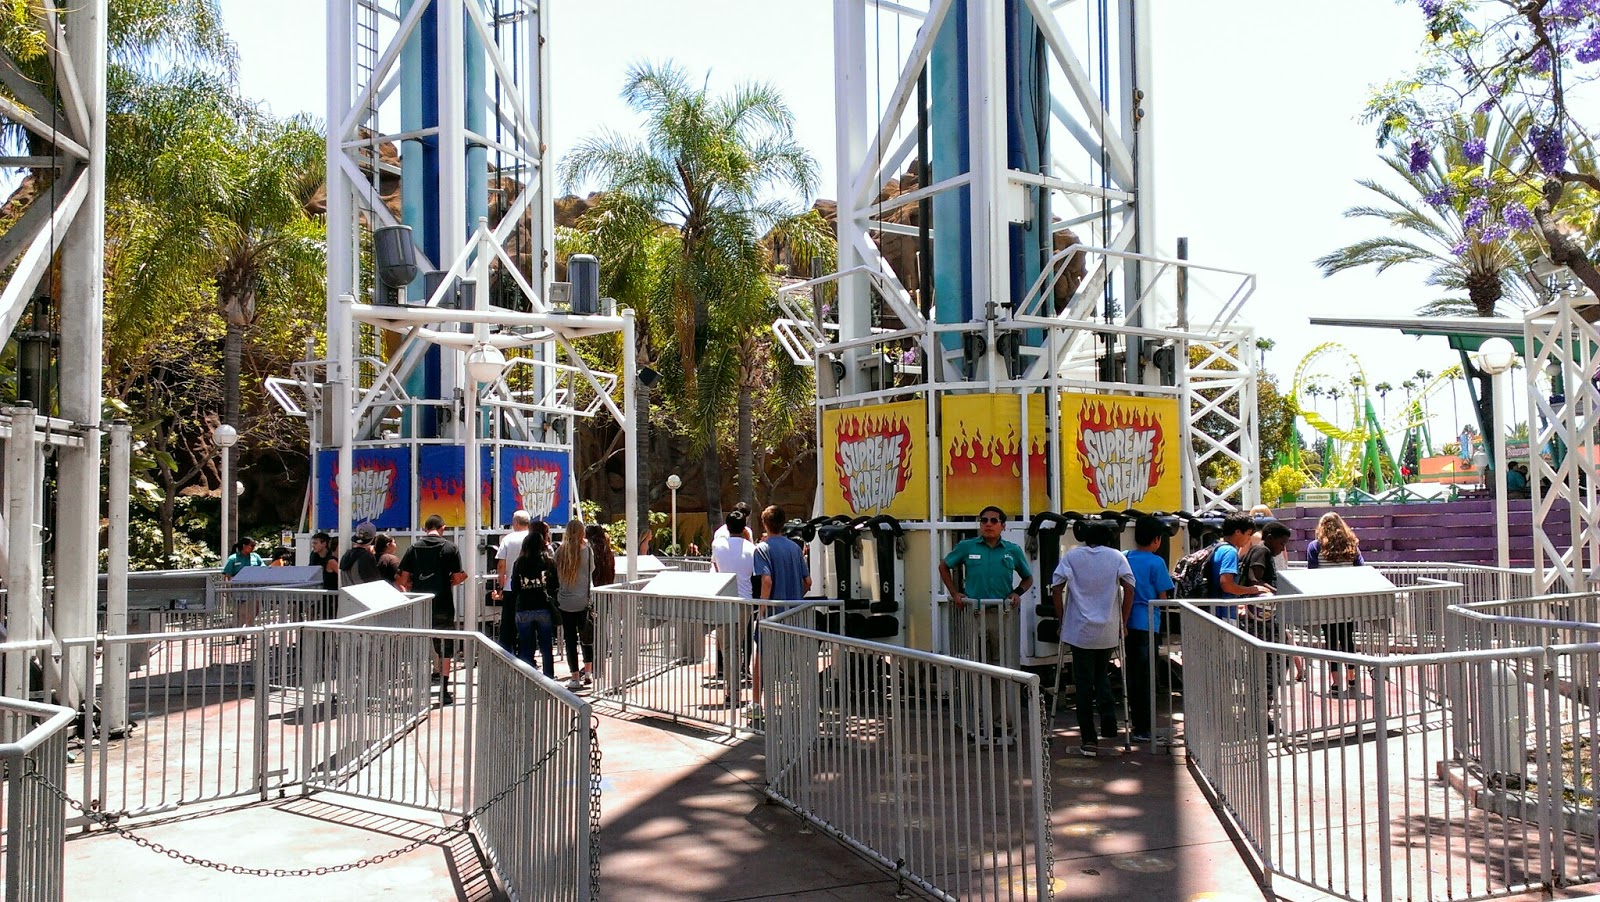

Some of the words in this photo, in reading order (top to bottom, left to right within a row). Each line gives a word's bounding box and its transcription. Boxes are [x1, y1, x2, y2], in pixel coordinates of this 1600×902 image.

[840, 433, 904, 477] SUPREME
[1083, 428, 1156, 468] SUPREME
[335, 469, 392, 495] PREME
[515, 470, 558, 496] SUPREME
[849, 467, 899, 515] SCREAM
[1095, 461, 1151, 510] SCREAM
[350, 492, 387, 523] CREAM
[522, 491, 555, 521] SCREAM
[840, 580, 847, 592] 5
[883, 581, 890, 594] 6
